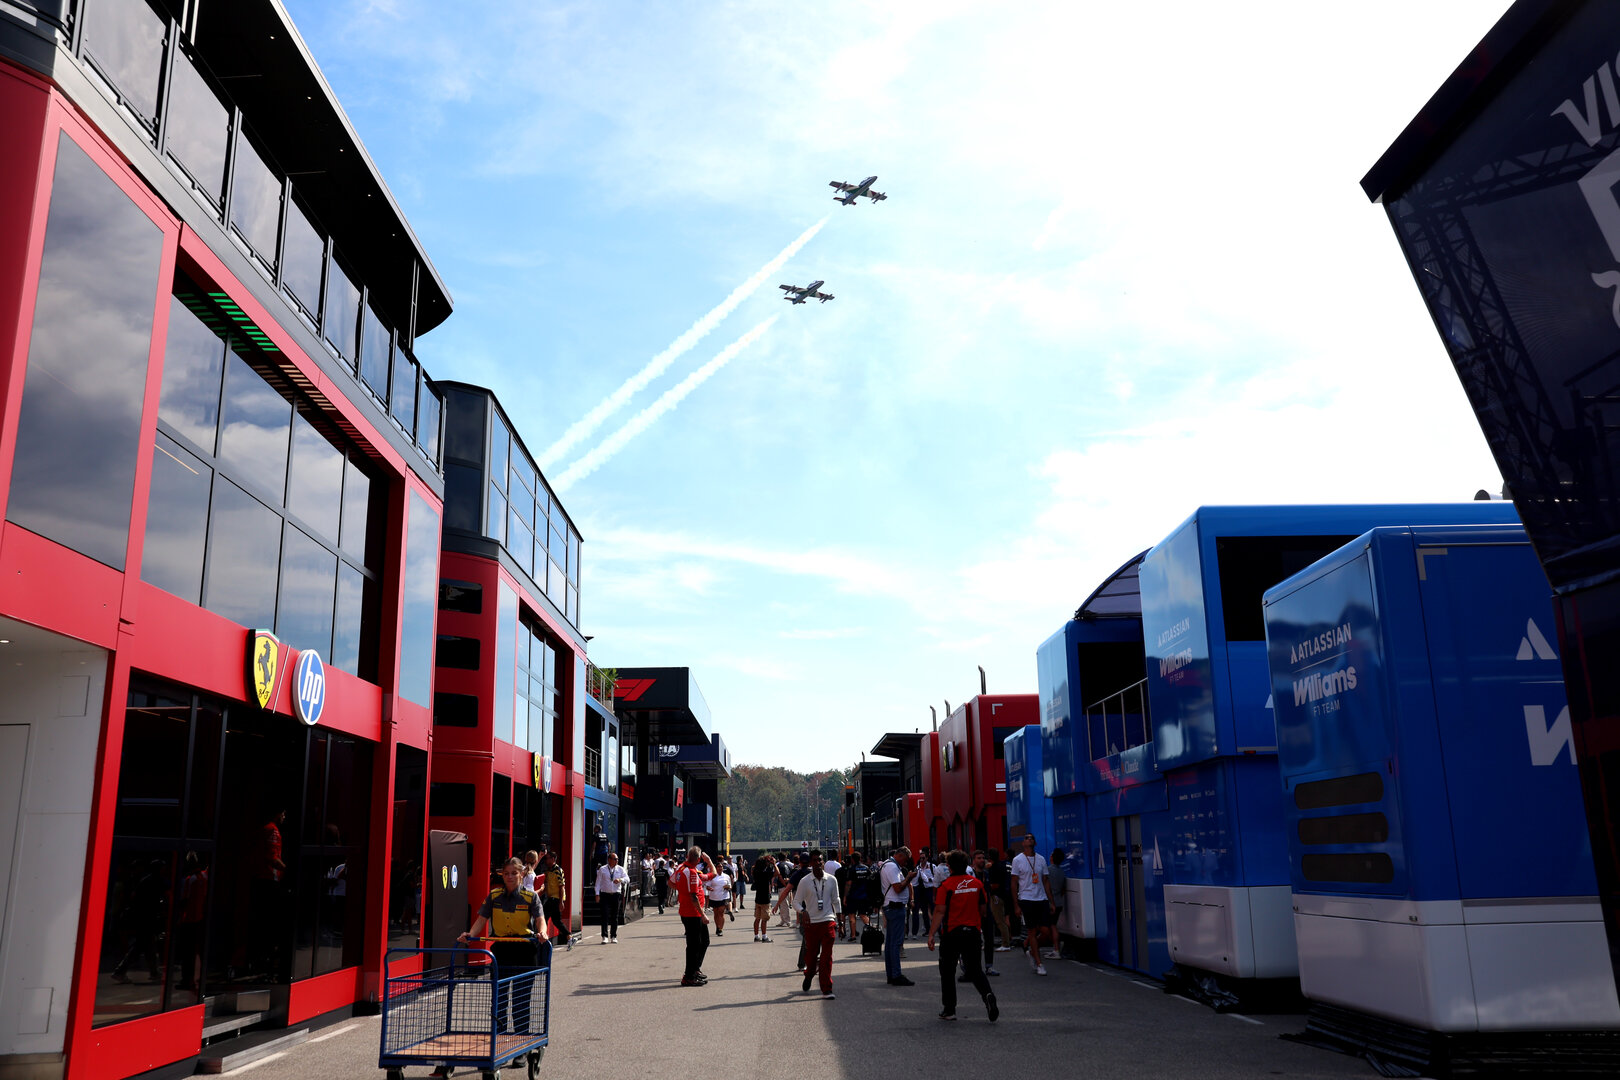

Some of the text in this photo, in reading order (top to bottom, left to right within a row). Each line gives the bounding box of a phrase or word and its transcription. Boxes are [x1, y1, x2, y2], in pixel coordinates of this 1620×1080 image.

[1550, 47, 1620, 147] VI
[1298, 621, 1352, 661] ATLASSIAN
[1159, 646, 1193, 678] Williams
[301, 652, 323, 722] hp
[1292, 665, 1358, 707] Williams
[1313, 699, 1341, 718] F1 TEAM
